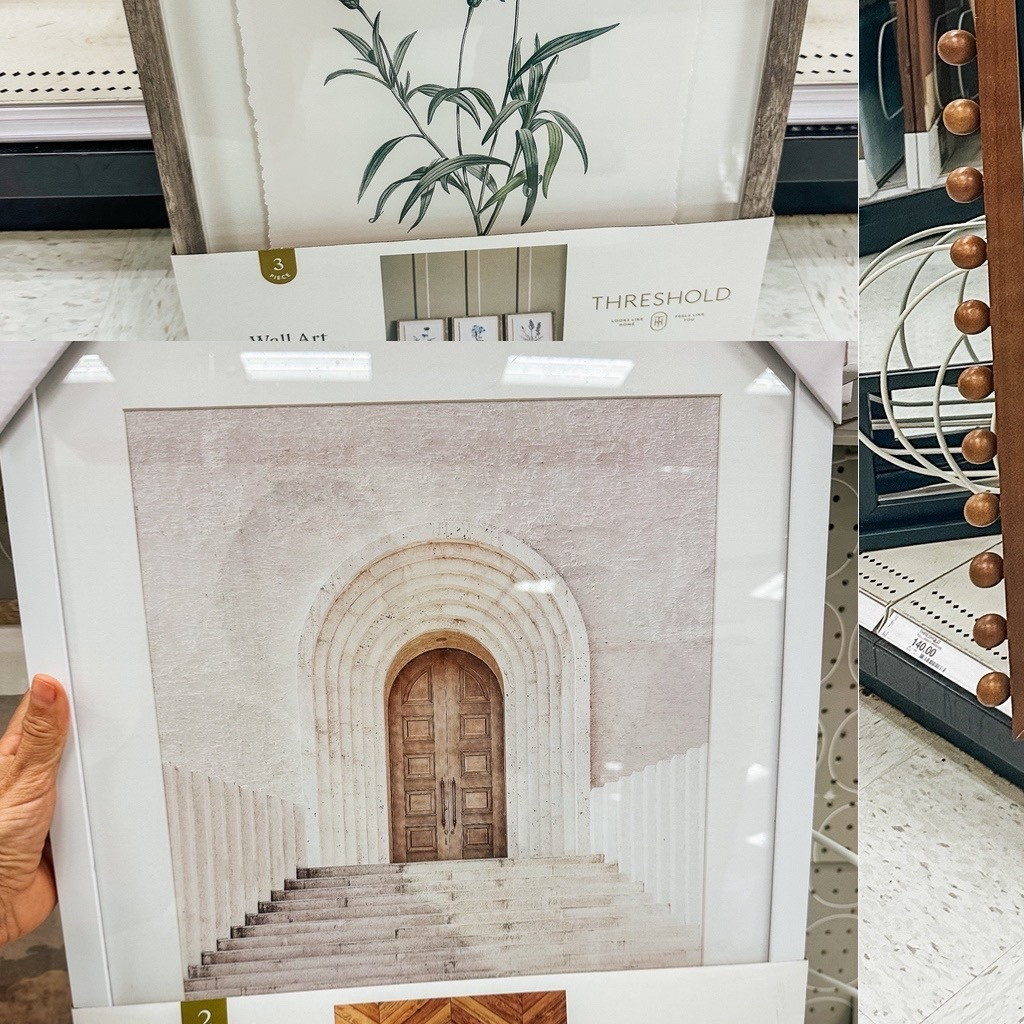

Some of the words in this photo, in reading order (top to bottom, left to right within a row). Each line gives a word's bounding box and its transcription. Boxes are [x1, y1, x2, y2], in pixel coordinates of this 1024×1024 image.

[273, 258, 284, 271] 3
[269, 272, 291, 280] PIECE
[592, 287, 732, 310] THRESHOLD
[911, 638, 937, 657] 140.00
[197, 1009, 211, 1024] 2
